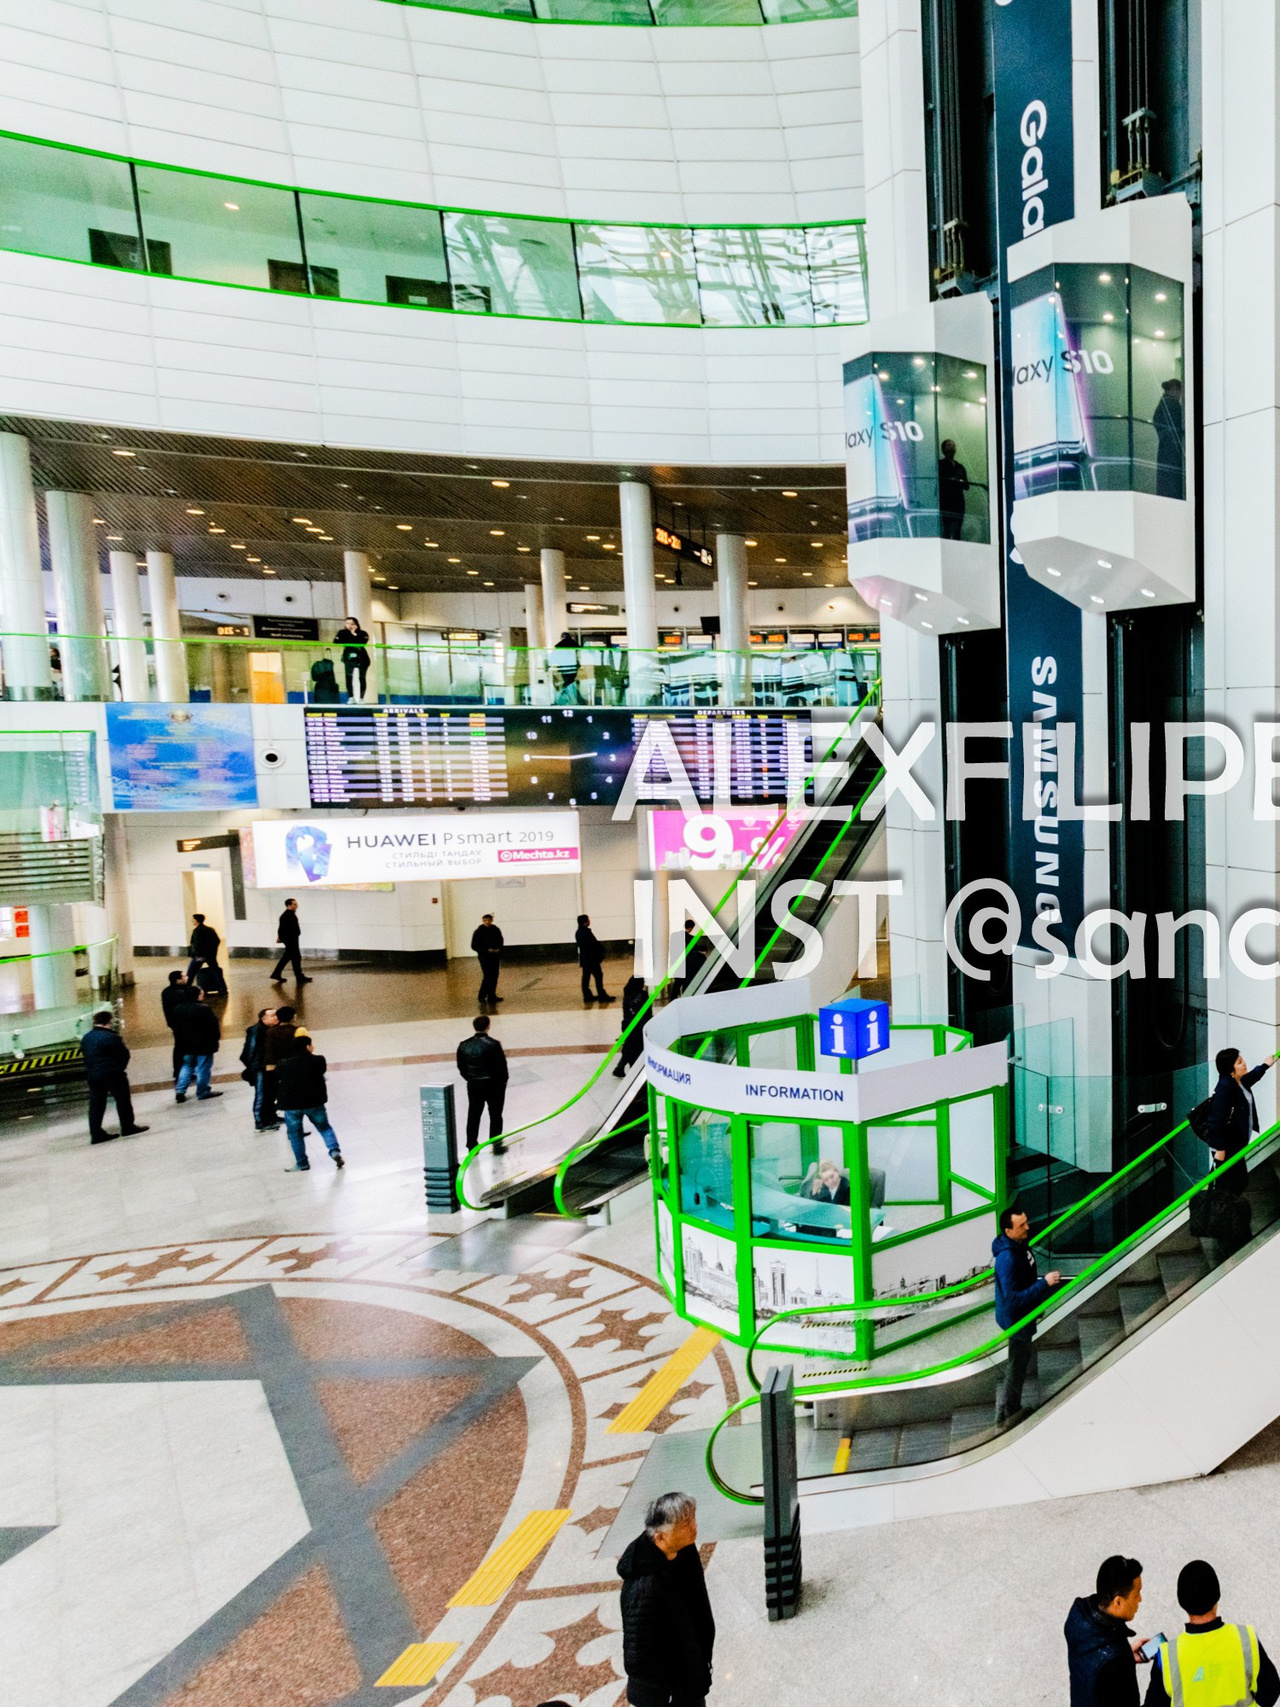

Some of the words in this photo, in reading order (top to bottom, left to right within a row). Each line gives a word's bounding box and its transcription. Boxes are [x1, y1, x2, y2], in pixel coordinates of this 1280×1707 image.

[1061, 349, 1114, 375] S10
[880, 420, 924, 442] S10
[563, 709, 573, 718] 12
[541, 715, 552, 723] 11
[586, 715, 593, 723] 1
[525, 731, 537, 740] 10
[602, 732, 610, 740] 2
[523, 753, 531, 762] 9
[609, 753, 616, 762] 3
[530, 776, 538, 784] 8
[605, 776, 613, 784] 4
[1031, 655, 1061, 922] SAMSUNG
[548, 792, 554, 800] 7
[591, 792, 598, 800] 5
[569, 798, 577, 806] 6
[346, 833, 436, 849] HUAWEI
[444, 832, 454, 845] P
[457, 831, 513, 845] smart
[519, 830, 554, 843] 2019
[512, 850, 570, 860] Mechta.kz
[745, 1084, 844, 1102] INFORMATION
